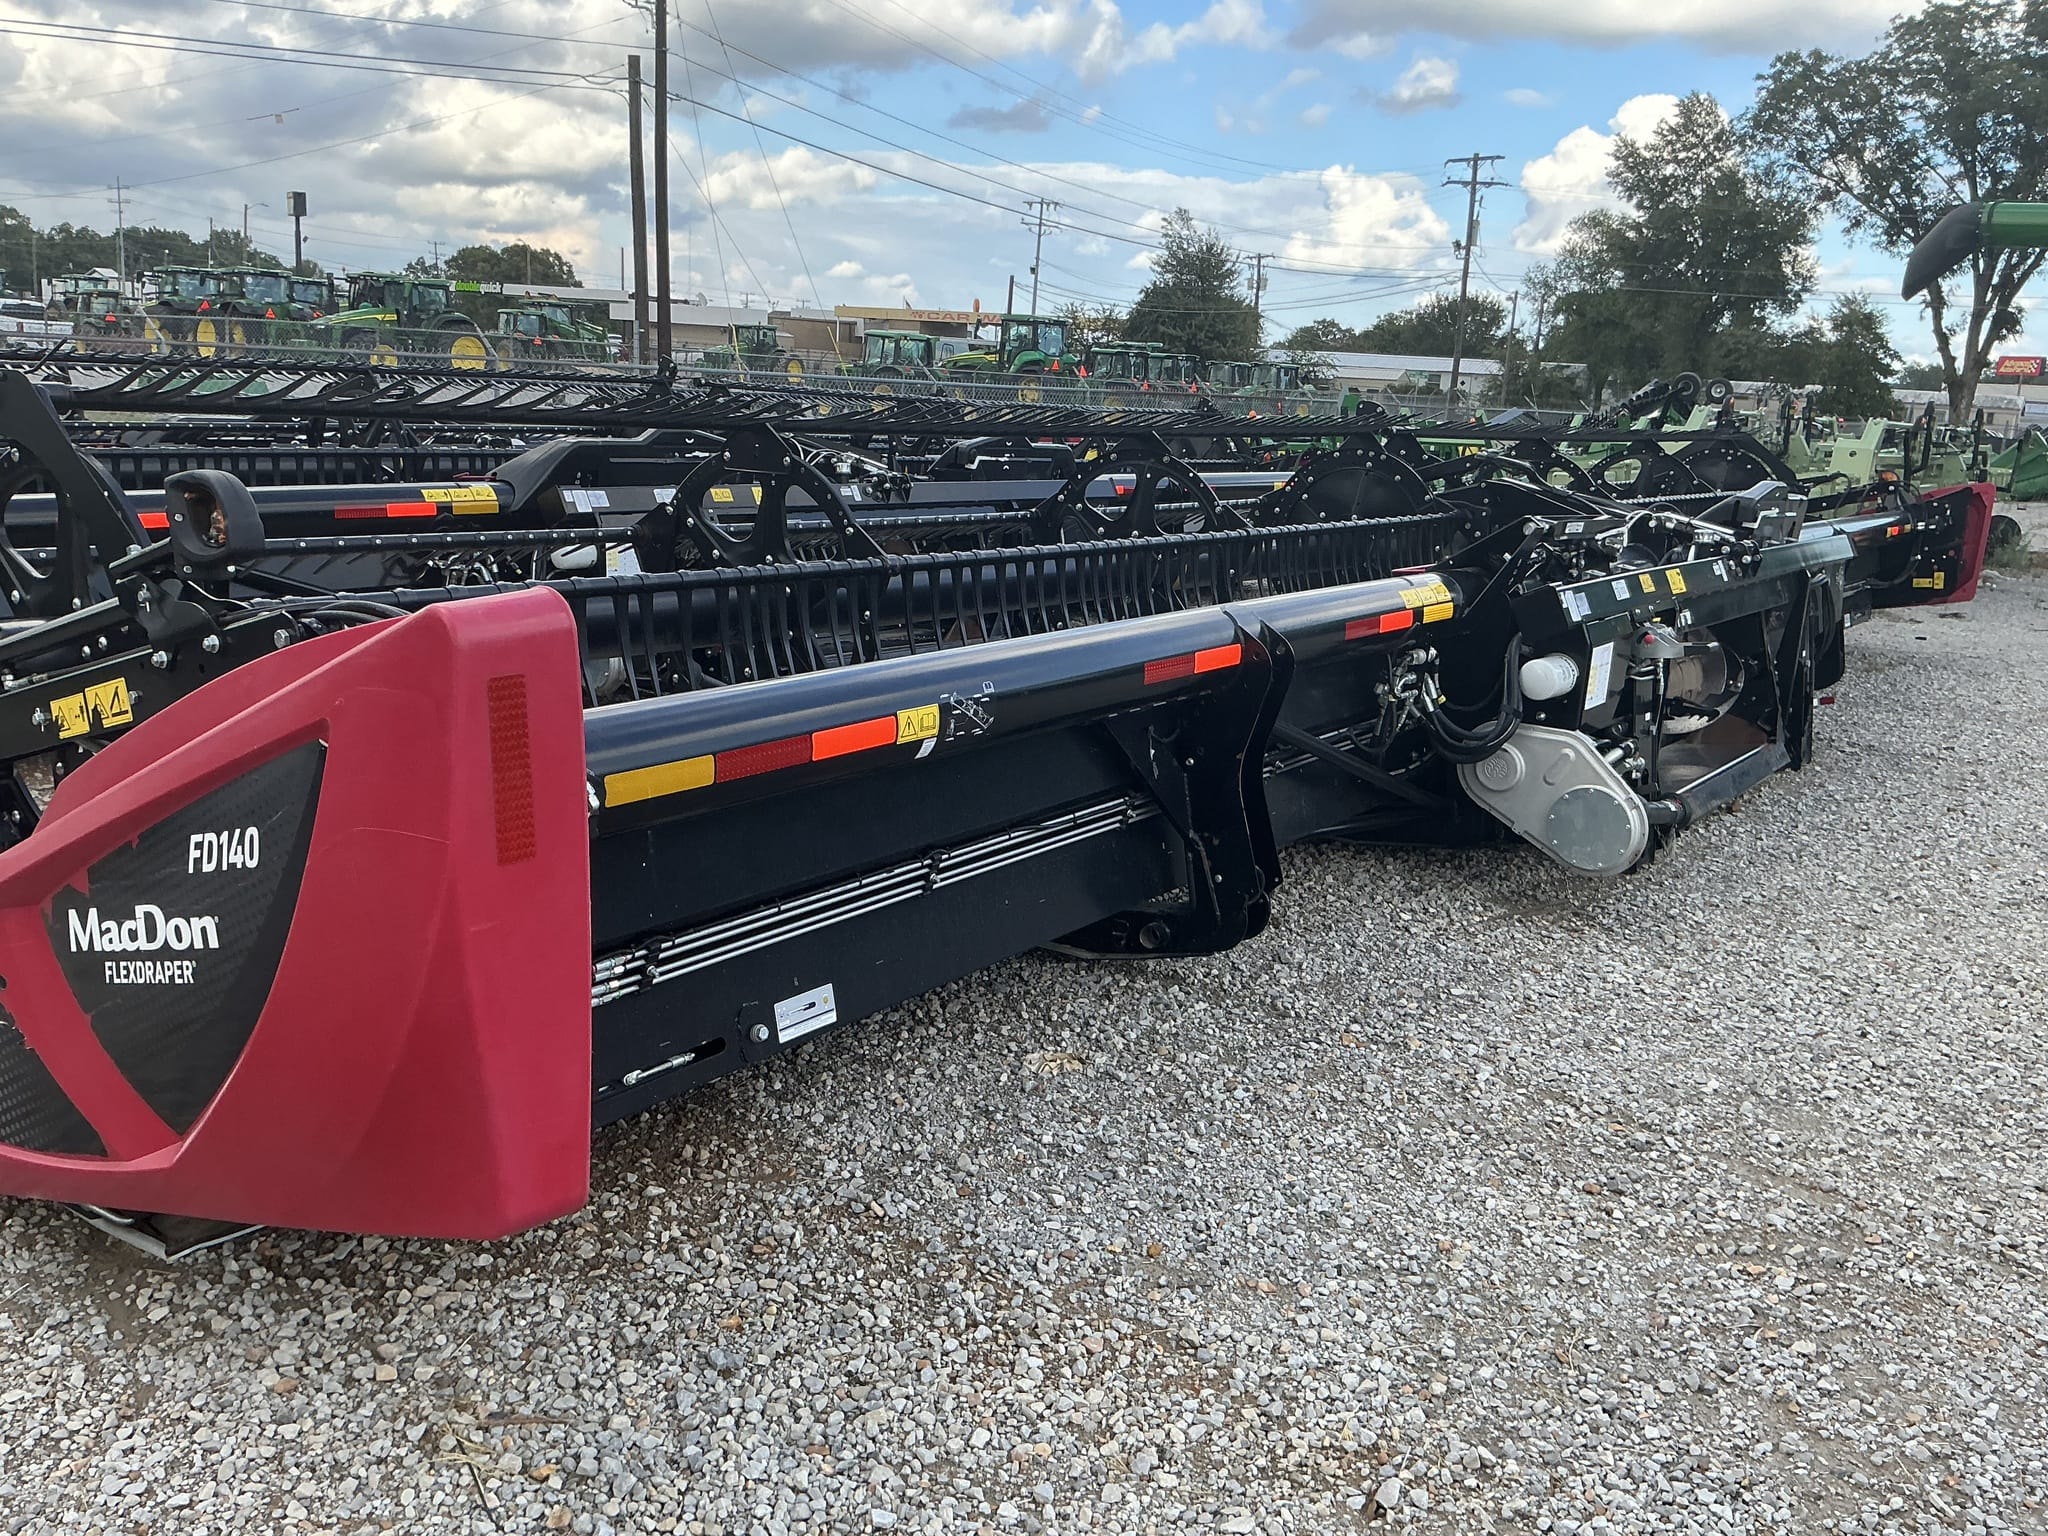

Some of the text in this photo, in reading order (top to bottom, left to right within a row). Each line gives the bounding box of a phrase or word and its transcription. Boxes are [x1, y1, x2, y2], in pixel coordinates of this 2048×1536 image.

[927, 312, 970, 323] CAR
[188, 826, 260, 874] FD140
[67, 904, 219, 952] MacDon
[104, 960, 196, 984] FLEXDRAPER
